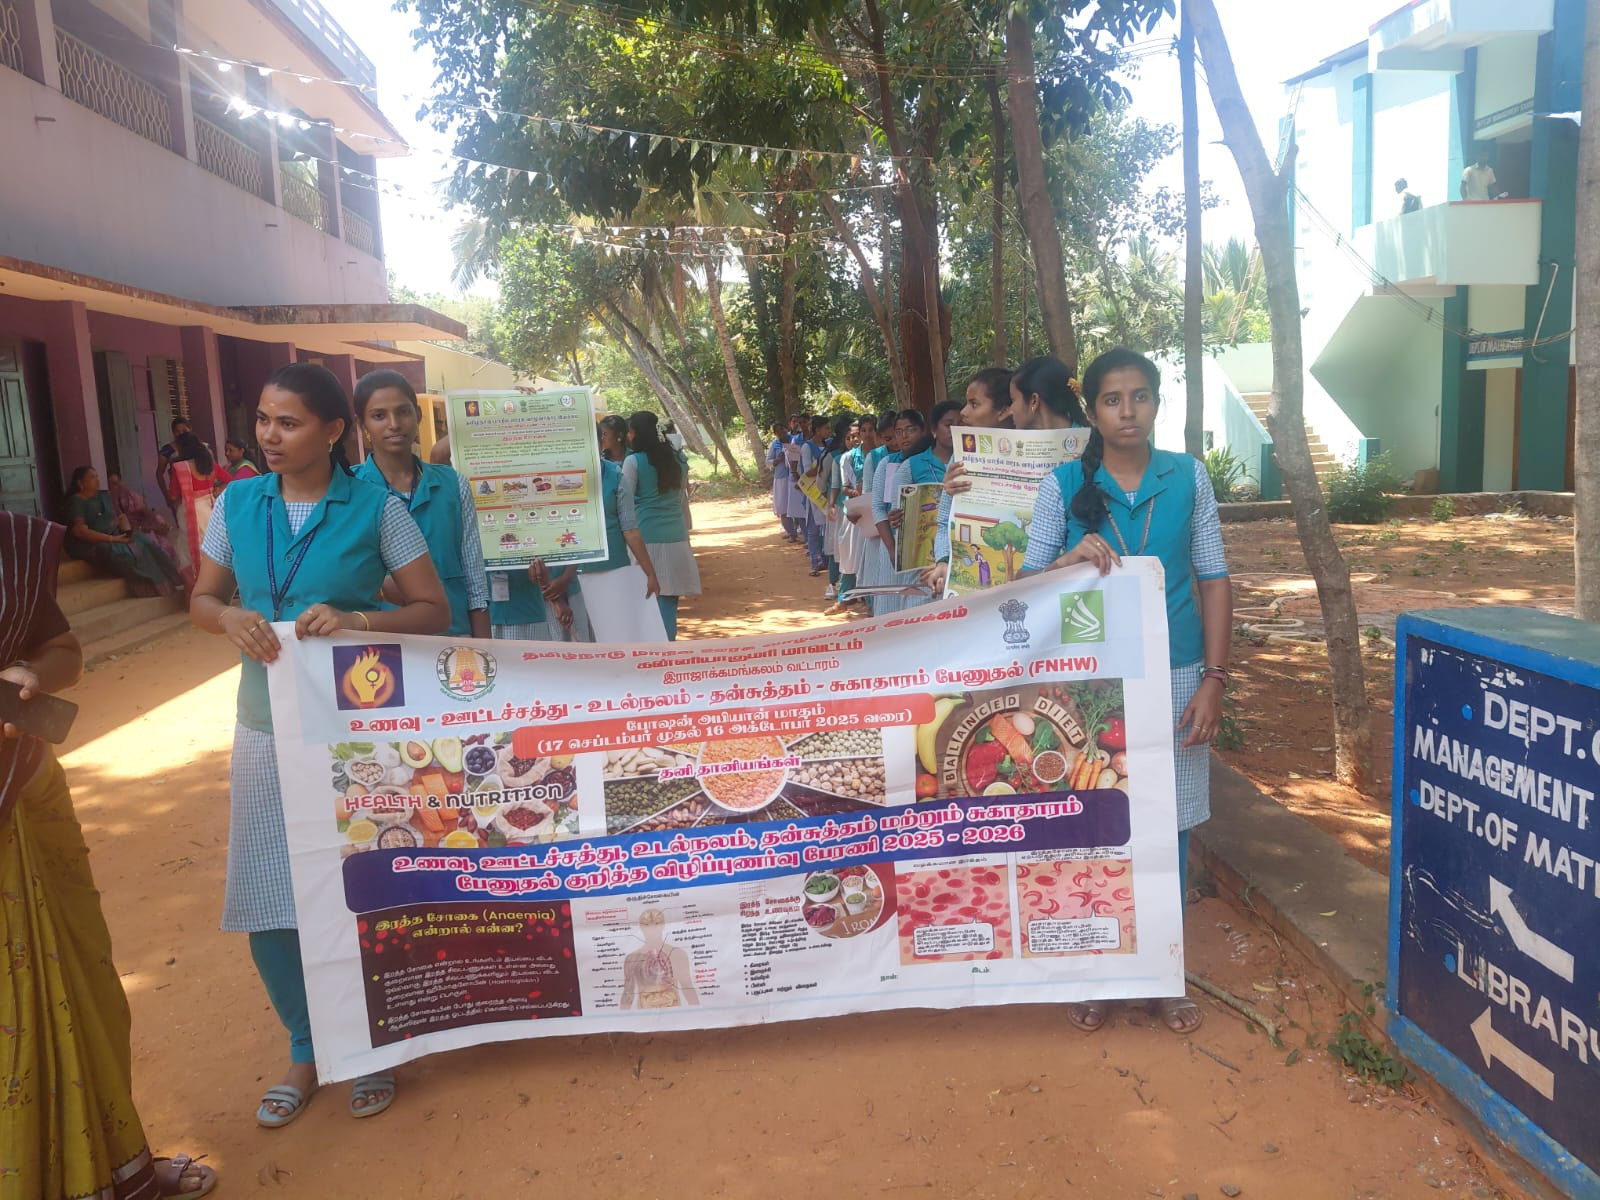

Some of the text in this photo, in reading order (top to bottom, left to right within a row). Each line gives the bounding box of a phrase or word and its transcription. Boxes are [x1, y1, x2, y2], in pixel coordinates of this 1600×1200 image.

[663, 656, 840, 684] இராஜாக்கமங்கலம் வட்டாரம்
[349, 715, 421, 733] உணவு
[441, 703, 568, 728] ஊட்டச்சத்து
[588, 688, 692, 713] உடல்நலம்
[709, 678, 811, 705] தன்சுத்தம்
[829, 669, 930, 693] சுகாதாரம்
[935, 668, 1024, 689] பேணுதல்
[1029, 657, 1098, 679] (FNHW)
[626, 703, 826, 732] போஷன் அபியான் மாதம்
[537, 708, 912, 754] (17 செப்டம்பர் முதல் 16 அக்டோபர் 2025 வரை)
[945, 696, 1082, 782] BALANCED DIET
[659, 755, 801, 781] தனி தானியங்கள்
[1413, 724, 1594, 830] MANAGEMENT
[345, 794, 422, 811] HEALTH
[427, 791, 440, 808] &
[393, 795, 1083, 871] உணவு, ஊட்டச்சத்து, உடல்நலம், தன்சுத்தம் மற்றும் சுகாதாரம்
[1419, 778, 1600, 900] DEPT.OF MAT
[457, 872, 560, 895] பேணுதல்
[565, 863, 649, 892] குறித்த
[653, 849, 798, 880] விழிப்புணர்வு
[803, 836, 879, 862] பேரணி
[883, 830, 943, 851] 2025
[962, 825, 1026, 844] 2026
[375, 908, 556, 931] இரத்த சோகை (Anaemia)
[412, 923, 524, 939] என்றால் என்ன?
